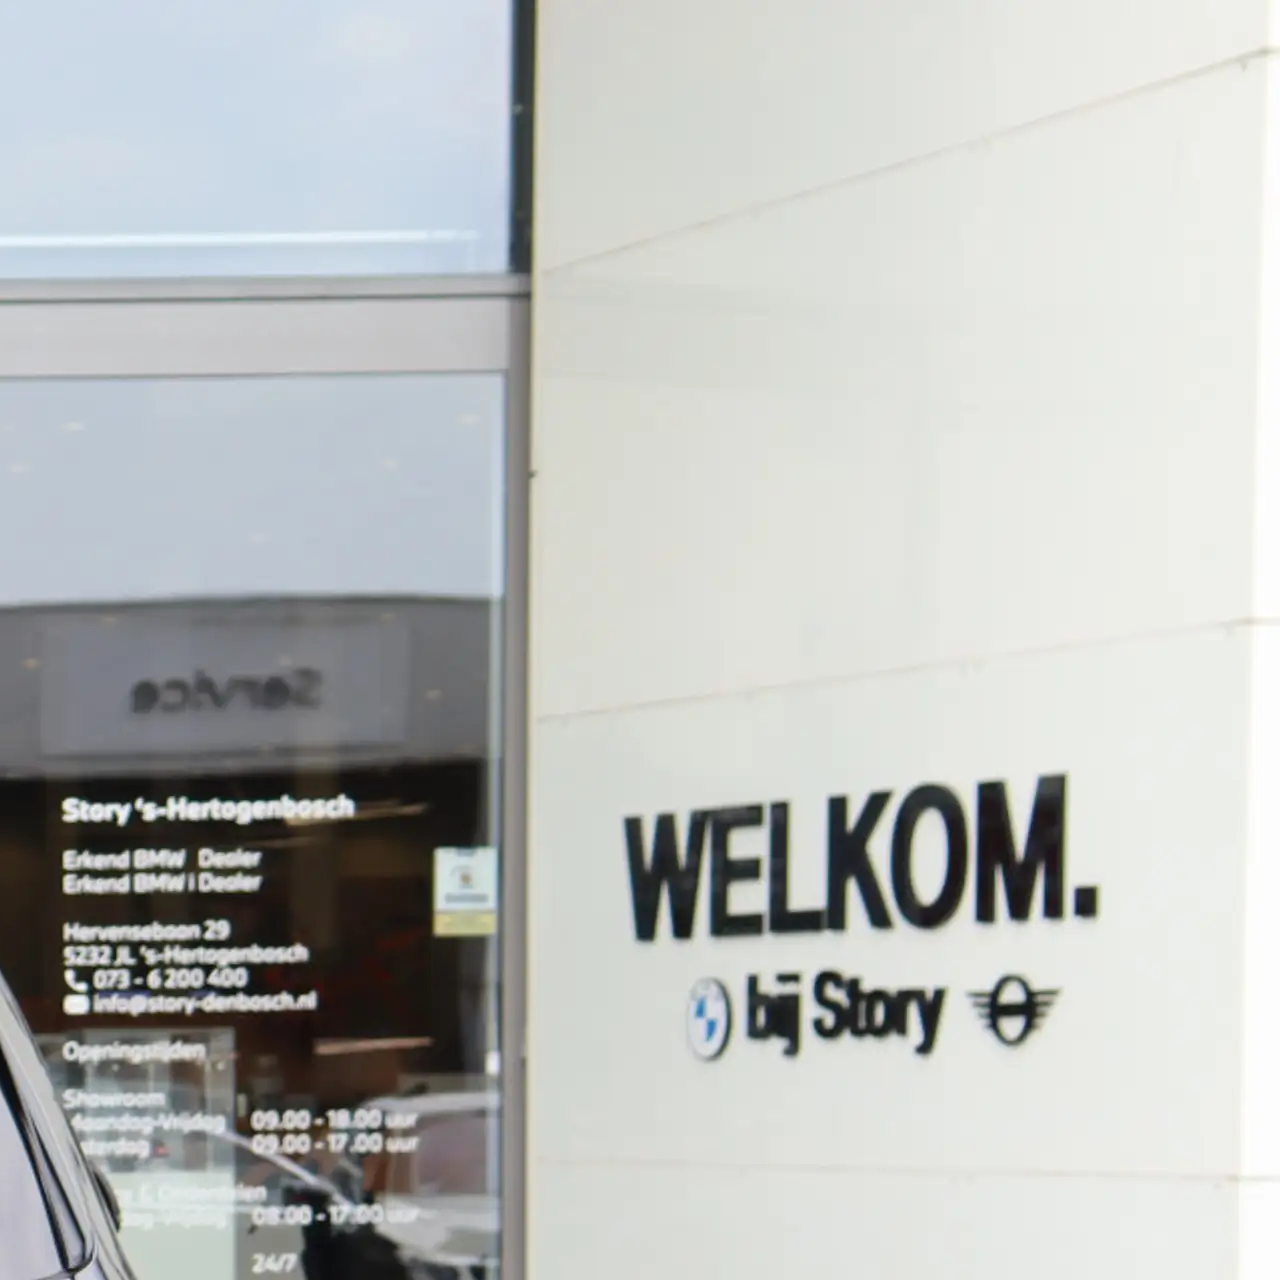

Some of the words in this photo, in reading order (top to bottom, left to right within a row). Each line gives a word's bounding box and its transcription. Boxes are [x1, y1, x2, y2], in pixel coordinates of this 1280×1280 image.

[62, 797, 132, 827] Story
[62, 849, 131, 871] Erkend
[133, 848, 187, 869] BMW
[198, 847, 263, 869] Dealer
[623, 773, 1101, 943] WELKOM.
[62, 873, 131, 894] Erkend
[133, 872, 186, 893] BMW
[198, 871, 263, 892] Dealer
[203, 919, 231, 941] 29
[63, 945, 111, 967] 5232
[93, 968, 130, 989] 073
[146, 969, 161, 989] 6
[163, 968, 205, 988] 200
[207, 967, 249, 988] 400
[746, 972, 803, 1058] bij
[811, 969, 947, 1056] Story
[251, 1110, 311, 1131] 09.00
[251, 1252, 298, 1274] 24/7
